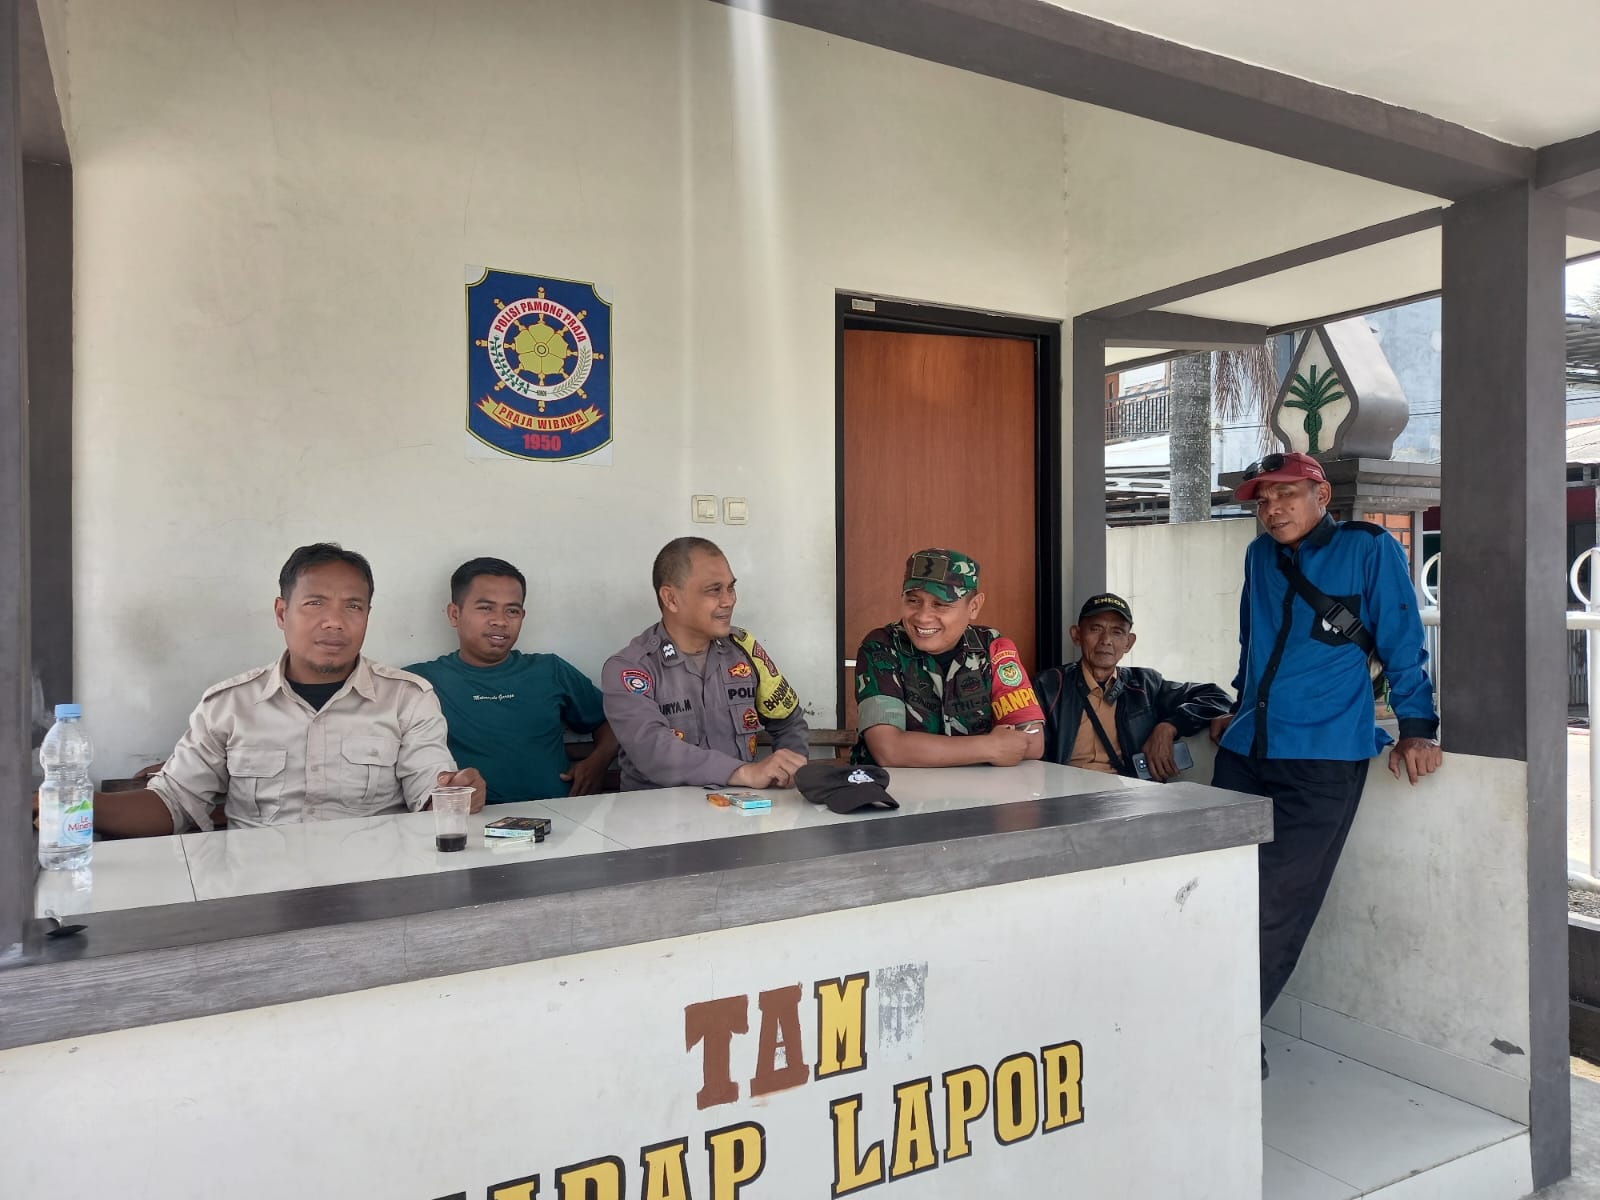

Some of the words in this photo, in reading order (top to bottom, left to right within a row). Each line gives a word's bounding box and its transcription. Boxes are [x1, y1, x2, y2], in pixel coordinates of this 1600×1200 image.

[495, 305, 521, 333] POLISI
[520, 301, 563, 318] PAMONG
[563, 313, 587, 343] PRAJA
[500, 407, 533, 428] PRAJA
[537, 413, 585, 430] WIBAWA
[522, 433, 562, 451] 1950
[728, 687, 756, 700] POLI
[991, 687, 1039, 720] DANPO
[658, 698, 692, 716] URYA.M
[830, 1039, 1085, 1200] LAPOR
